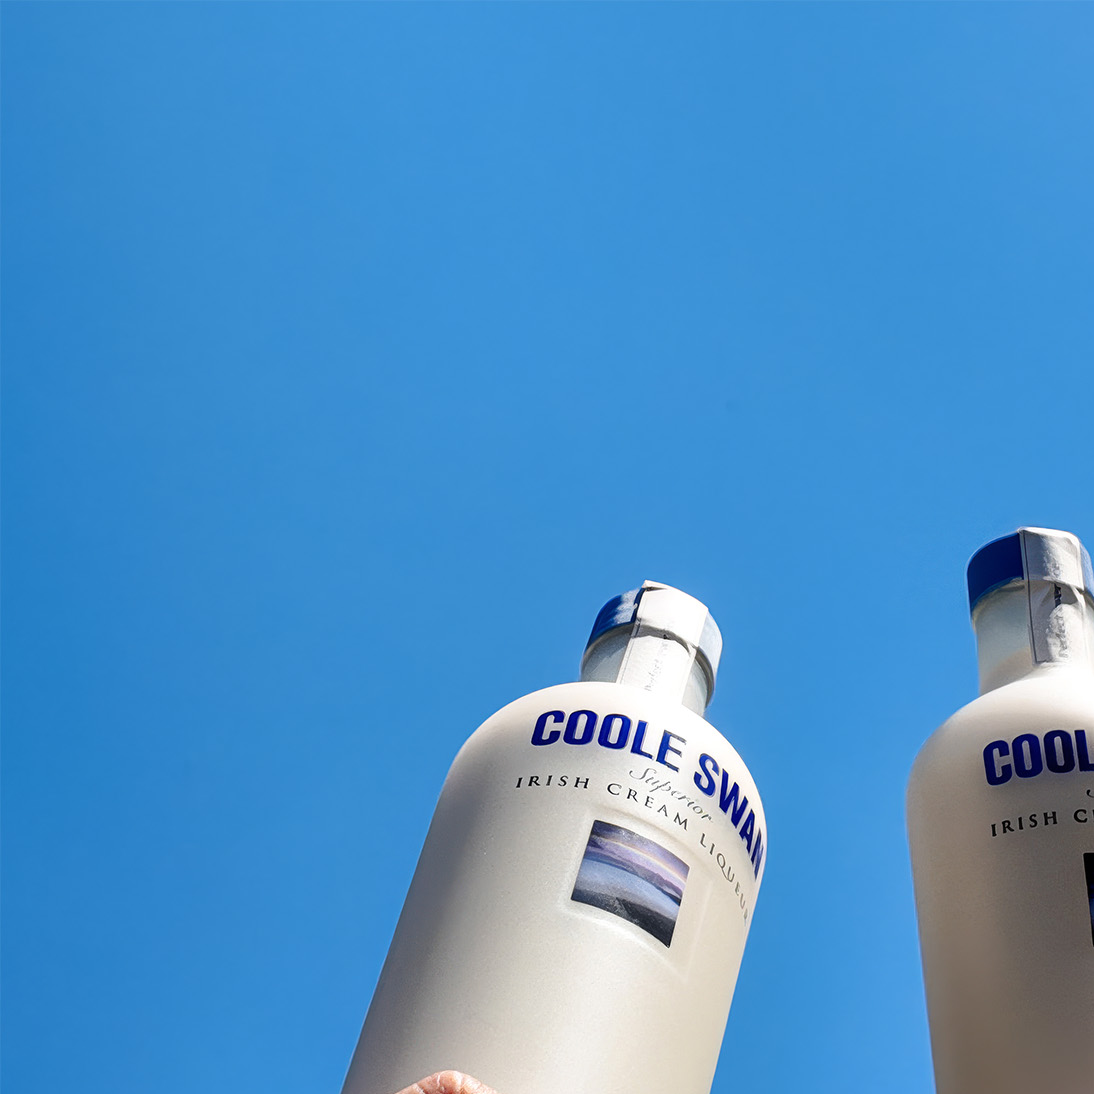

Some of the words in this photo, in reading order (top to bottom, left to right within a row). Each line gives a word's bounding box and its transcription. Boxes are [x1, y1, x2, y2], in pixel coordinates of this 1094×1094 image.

[515, 774, 590, 789] IRISH
[606, 782, 689, 831] CREAM
[531, 709, 688, 773] COOLE
[693, 752, 765, 882] SWAN
[628, 767, 713, 823] Superior
[991, 811, 1058, 837] IRISH
